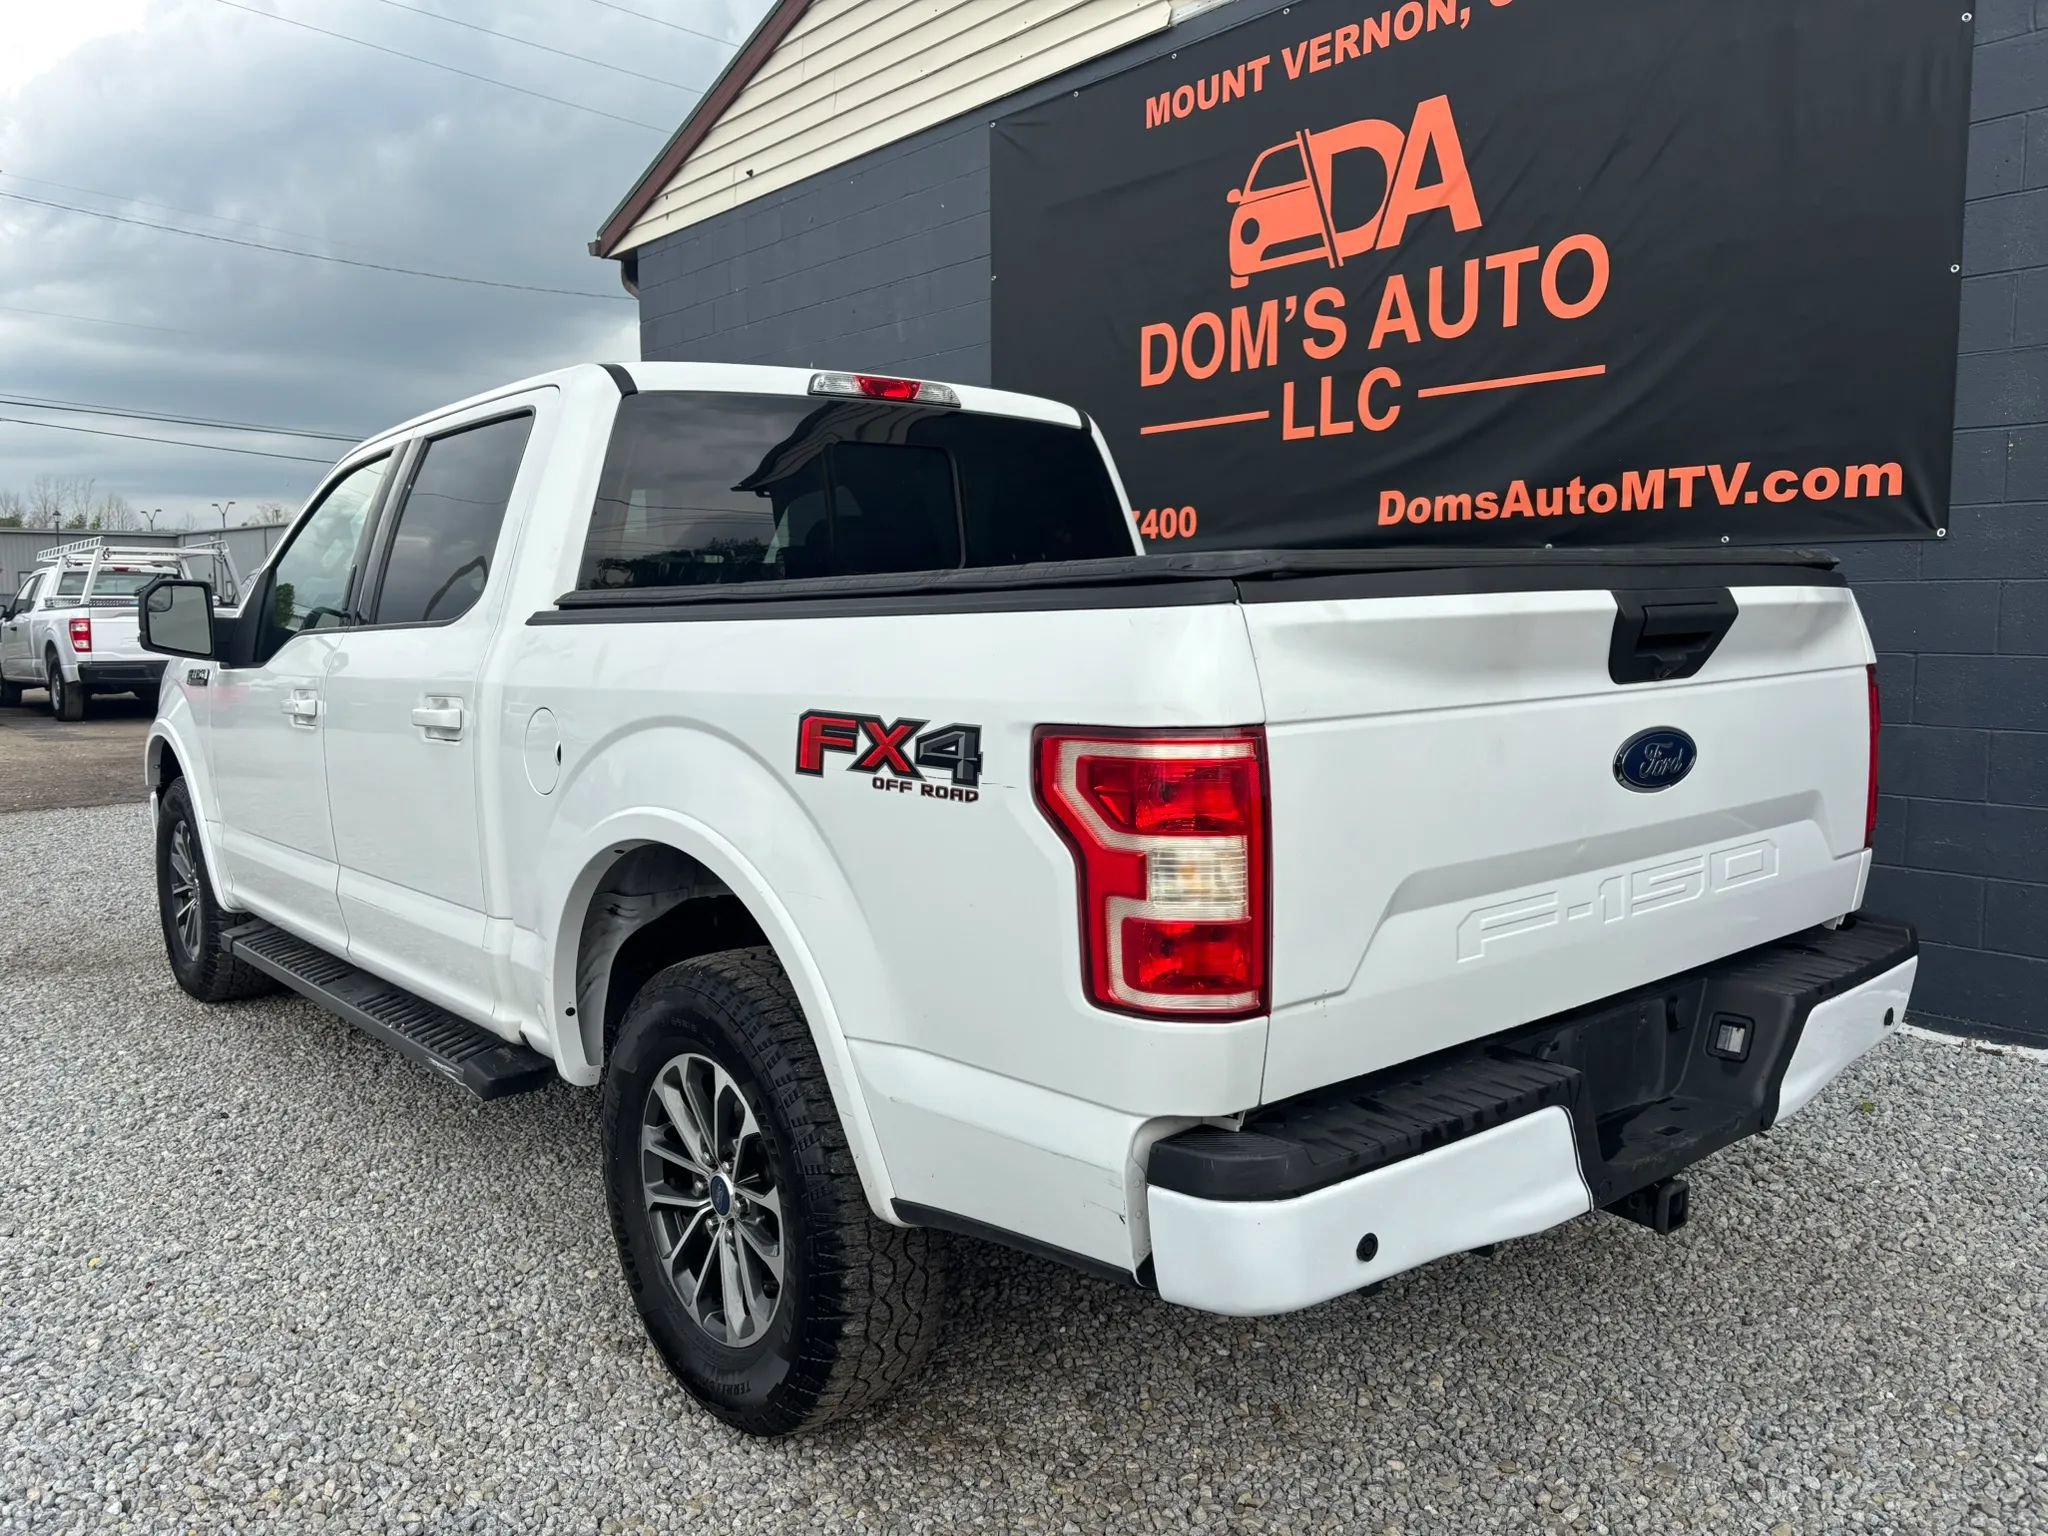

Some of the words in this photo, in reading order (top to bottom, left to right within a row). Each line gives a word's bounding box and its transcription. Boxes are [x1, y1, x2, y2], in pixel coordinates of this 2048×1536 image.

[1145, 56, 1270, 129] MOUNT
[1281, 0, 1471, 80] VERNON,
[1141, 287, 1347, 387] DOM'S
[1368, 233, 1610, 350] AUTO
[1282, 367, 1401, 441] LLC
[1377, 462, 1903, 526] DomsAutoMTV.com
[795, 708, 983, 789] FX4
[1639, 741, 1684, 779] Ford
[872, 776, 913, 794] OFF
[920, 783, 980, 803] ROAD
[1457, 838, 1779, 964] F-150
